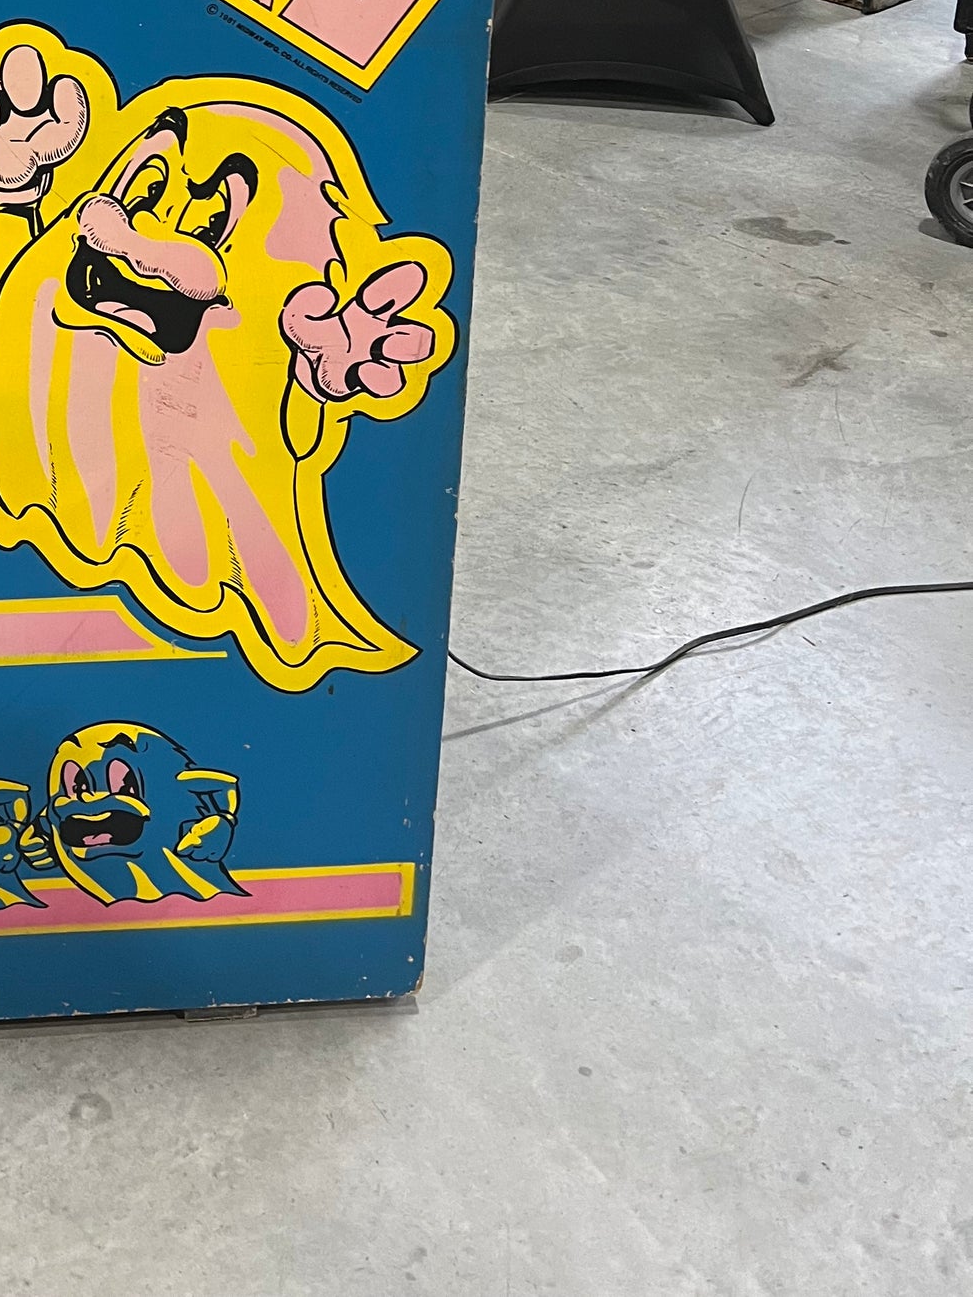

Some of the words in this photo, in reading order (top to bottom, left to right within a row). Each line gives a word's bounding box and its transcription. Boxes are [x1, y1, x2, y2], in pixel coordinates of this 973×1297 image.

[219, 12, 237, 26] 1981
[293, 58, 306, 70] ALL
[305, 65, 330, 84] RIGHTS
[329, 80, 363, 104] RESERVED
